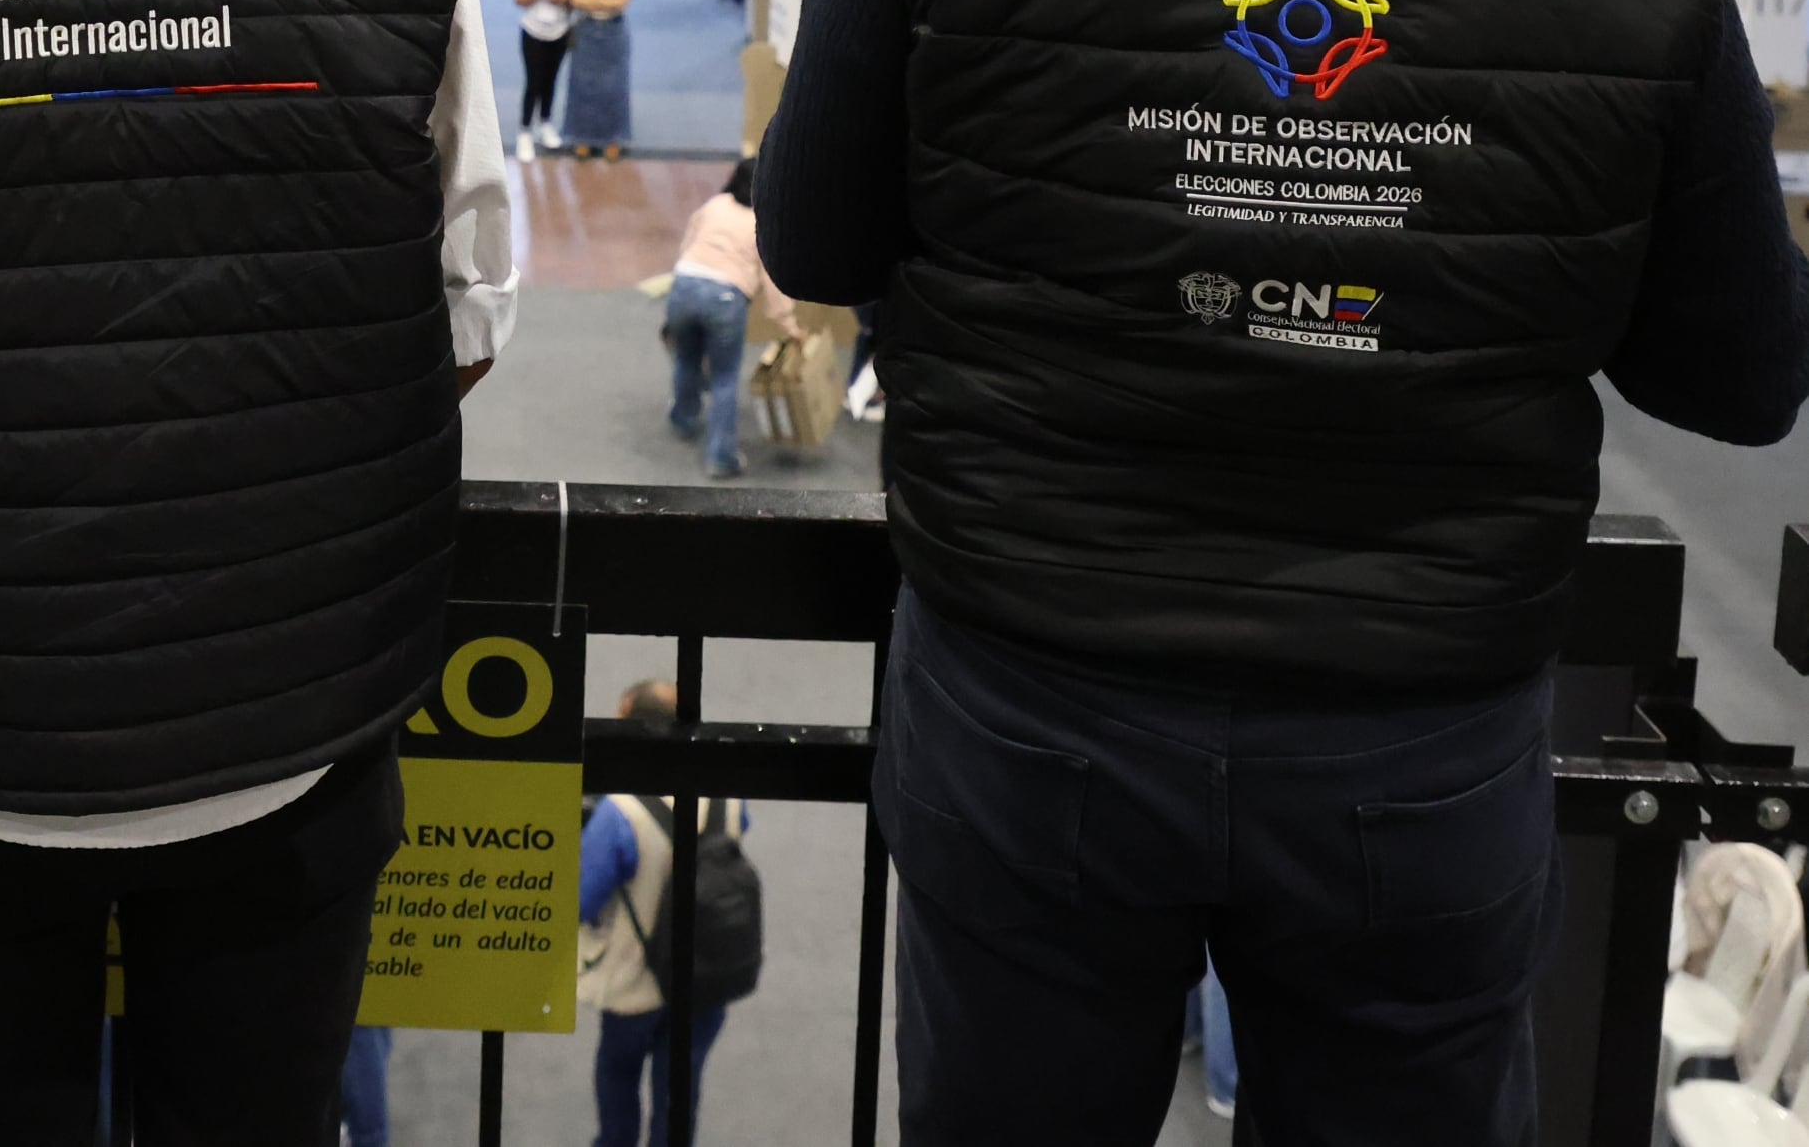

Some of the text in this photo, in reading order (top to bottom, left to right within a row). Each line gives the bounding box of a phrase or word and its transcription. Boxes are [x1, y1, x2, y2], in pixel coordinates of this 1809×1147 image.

[1, 5, 232, 61] Internacional
[1127, 102, 1472, 146] MISIÓN DE OBSERVACIÓN
[1185, 138, 1412, 172] INTERNACIONAL
[1175, 173, 1423, 203] ELECCIONES COLOMBIA 2026
[1187, 203, 1404, 229] LEGITIMIDAD Y TRANSPARENCIA
[1251, 327, 1374, 350] COLOMBIA
[417, 824, 456, 848] EN
[462, 823, 555, 851] VACÍO
[458, 868, 487, 889] de
[496, 870, 554, 891] edad
[397, 896, 447, 918] lado
[452, 898, 487, 920] del
[492, 901, 552, 922] vacío
[388, 926, 417, 947] de
[432, 932, 462, 949] un
[477, 931, 552, 952] adulto
